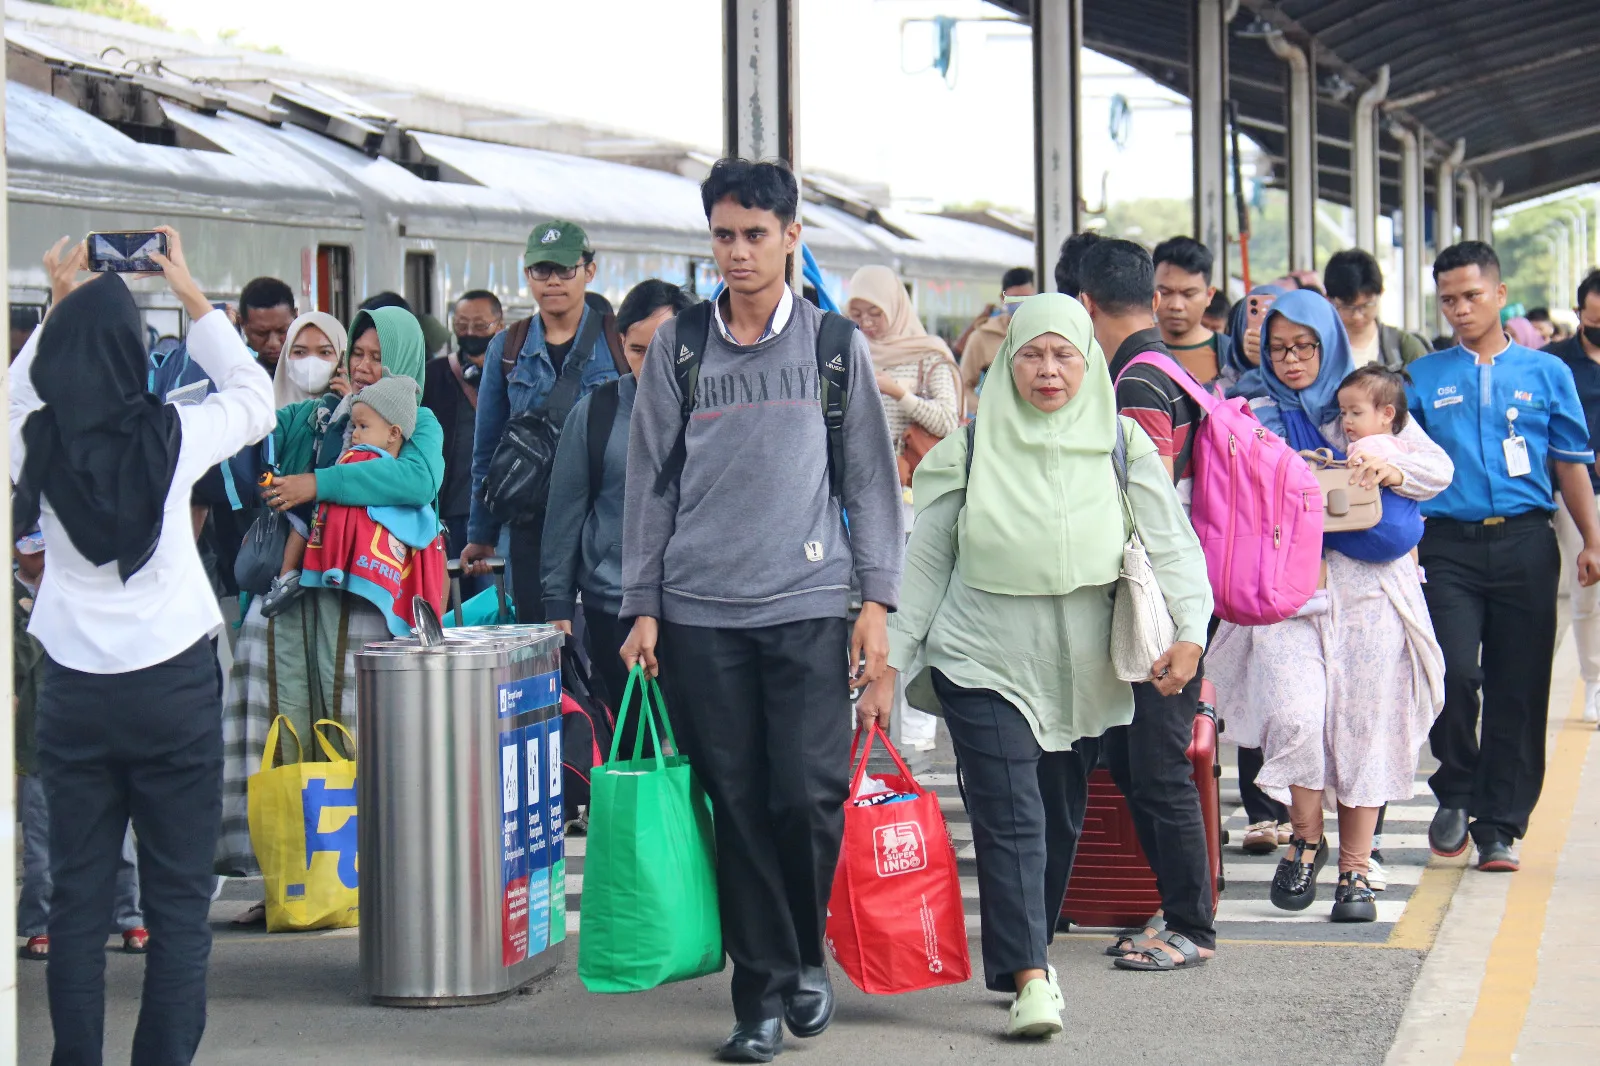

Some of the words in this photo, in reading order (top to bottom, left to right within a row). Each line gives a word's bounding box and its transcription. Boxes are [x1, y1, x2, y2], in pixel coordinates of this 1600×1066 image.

[825, 361, 846, 372] LEUSER
[887, 850, 915, 861] SUPER
[883, 856, 920, 872] INDO
